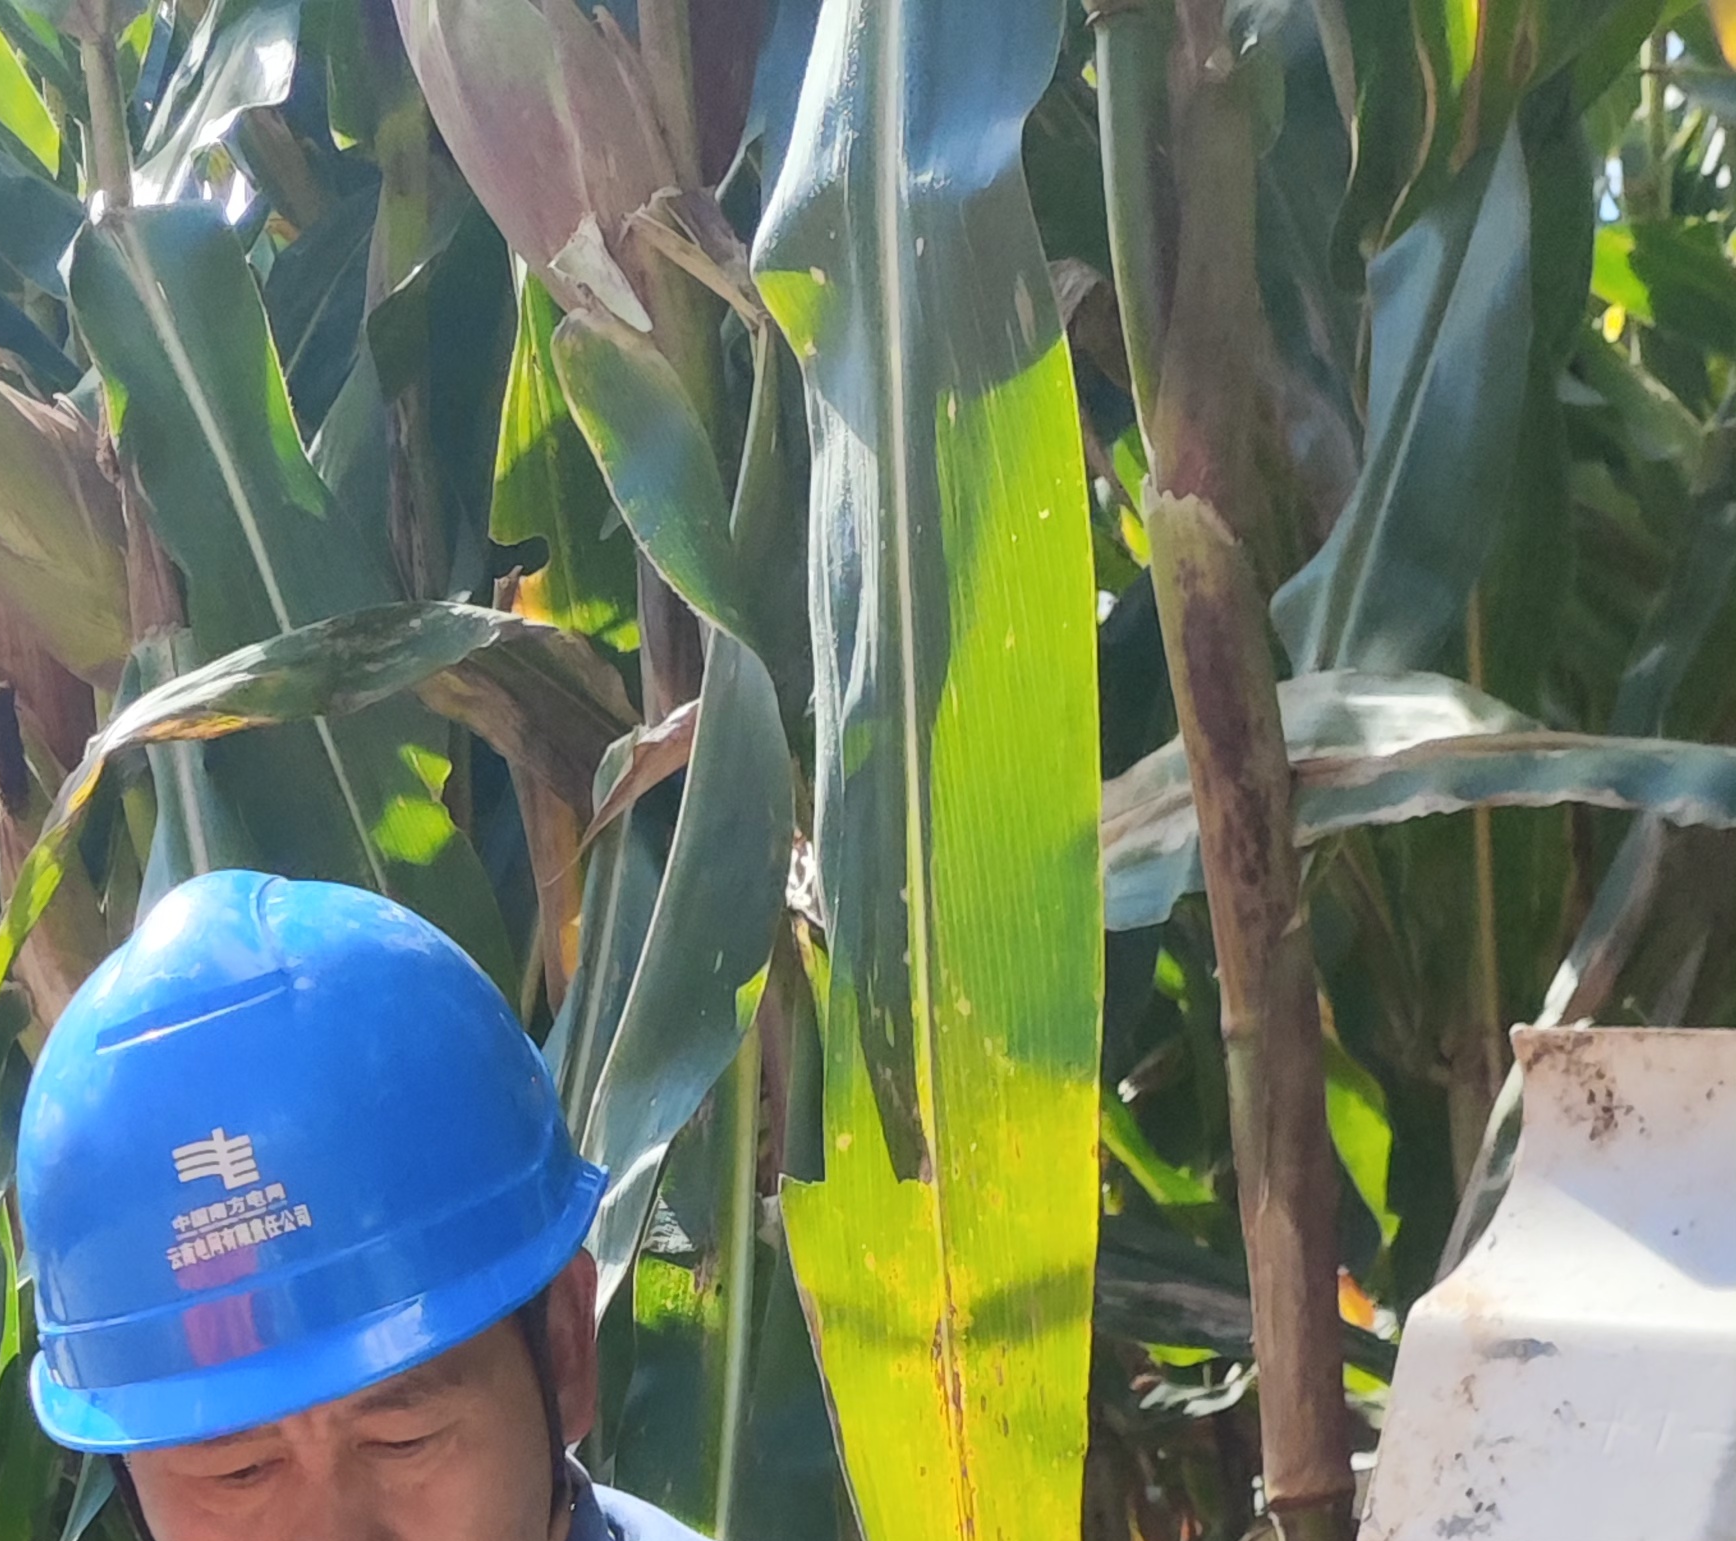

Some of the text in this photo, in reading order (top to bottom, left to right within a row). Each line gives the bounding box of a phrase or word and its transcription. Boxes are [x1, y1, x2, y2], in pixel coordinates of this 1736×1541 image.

[171, 1183, 286, 1232] 中国南方电网
